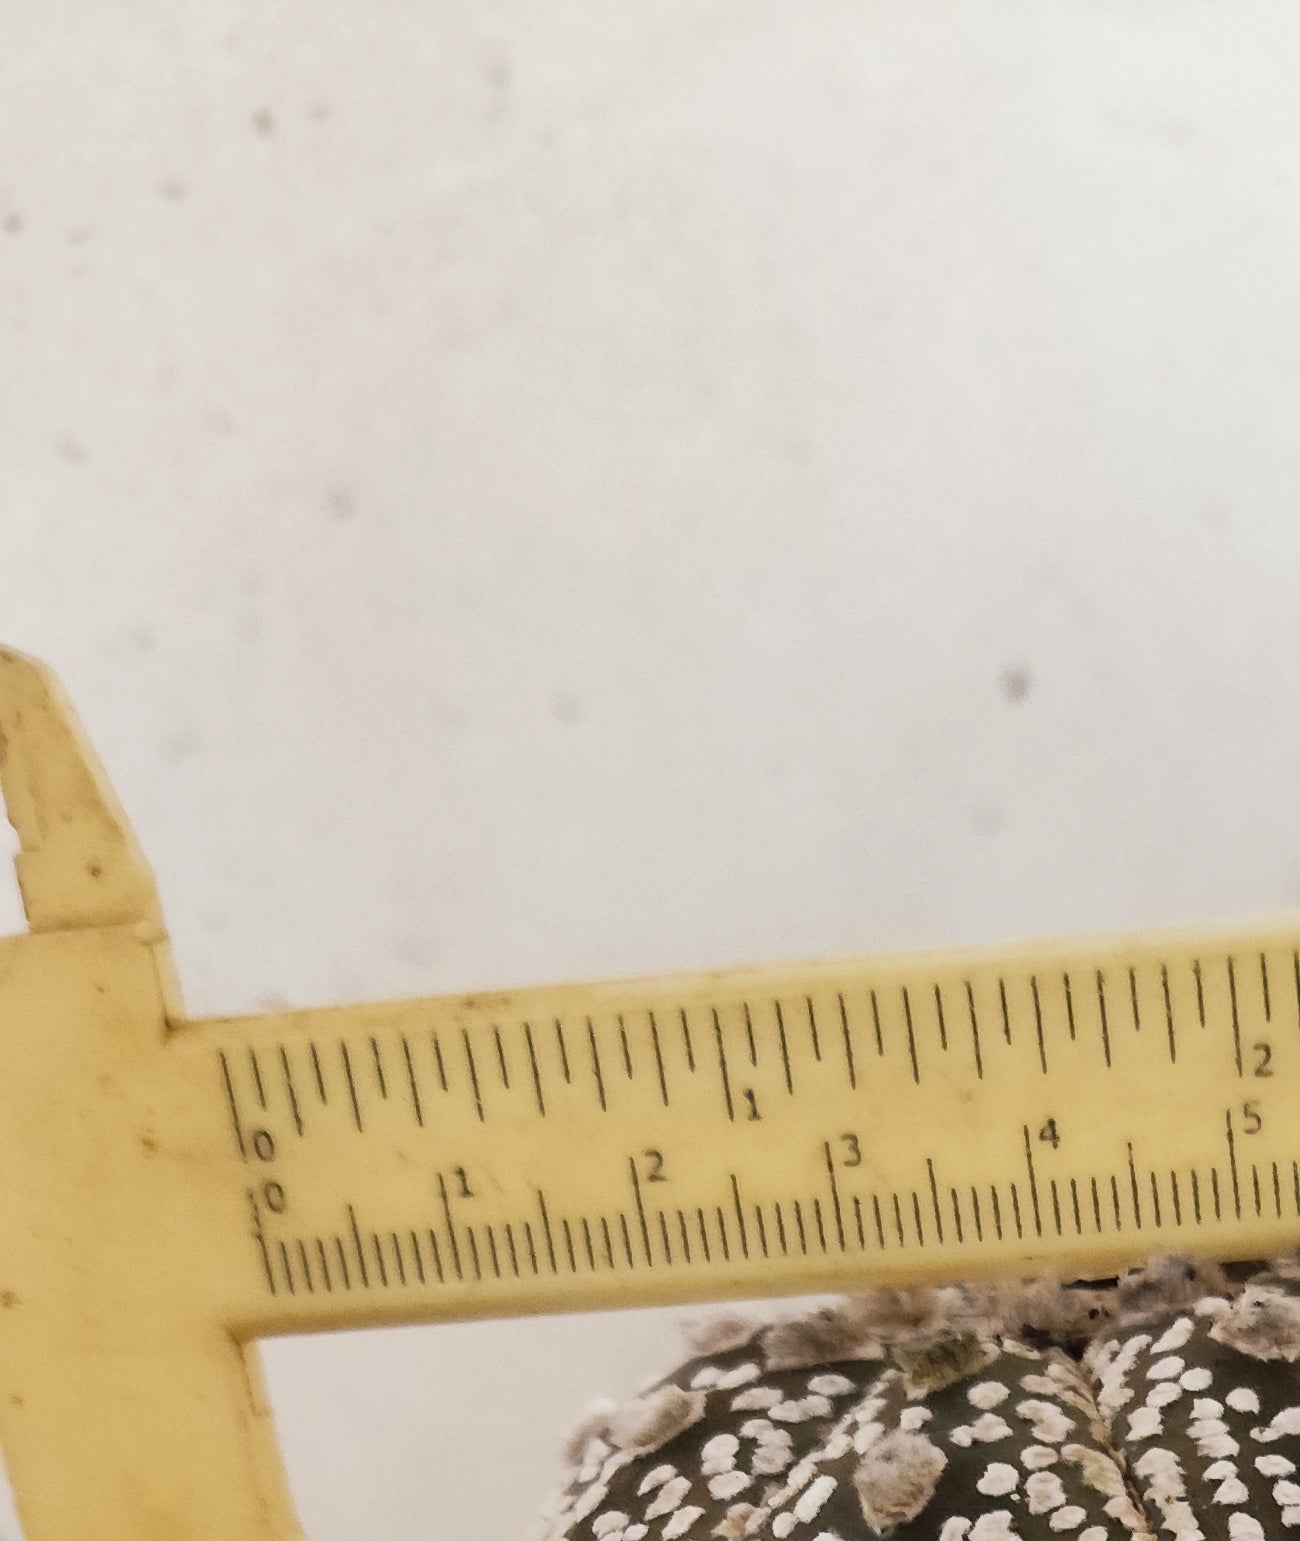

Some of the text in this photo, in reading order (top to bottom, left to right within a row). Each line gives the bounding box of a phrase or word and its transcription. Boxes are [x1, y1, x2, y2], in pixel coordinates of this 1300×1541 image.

[252, 1129, 275, 1163] 0
[743, 1087, 762, 1122] 1
[1252, 1043, 1274, 1078] 2
[262, 1180, 286, 1214] 0
[453, 1165, 475, 1198] 1
[643, 1149, 667, 1183] 2
[842, 1133, 863, 1168] 3
[1038, 1117, 1061, 1150] 4
[1241, 1101, 1264, 1136] 5
